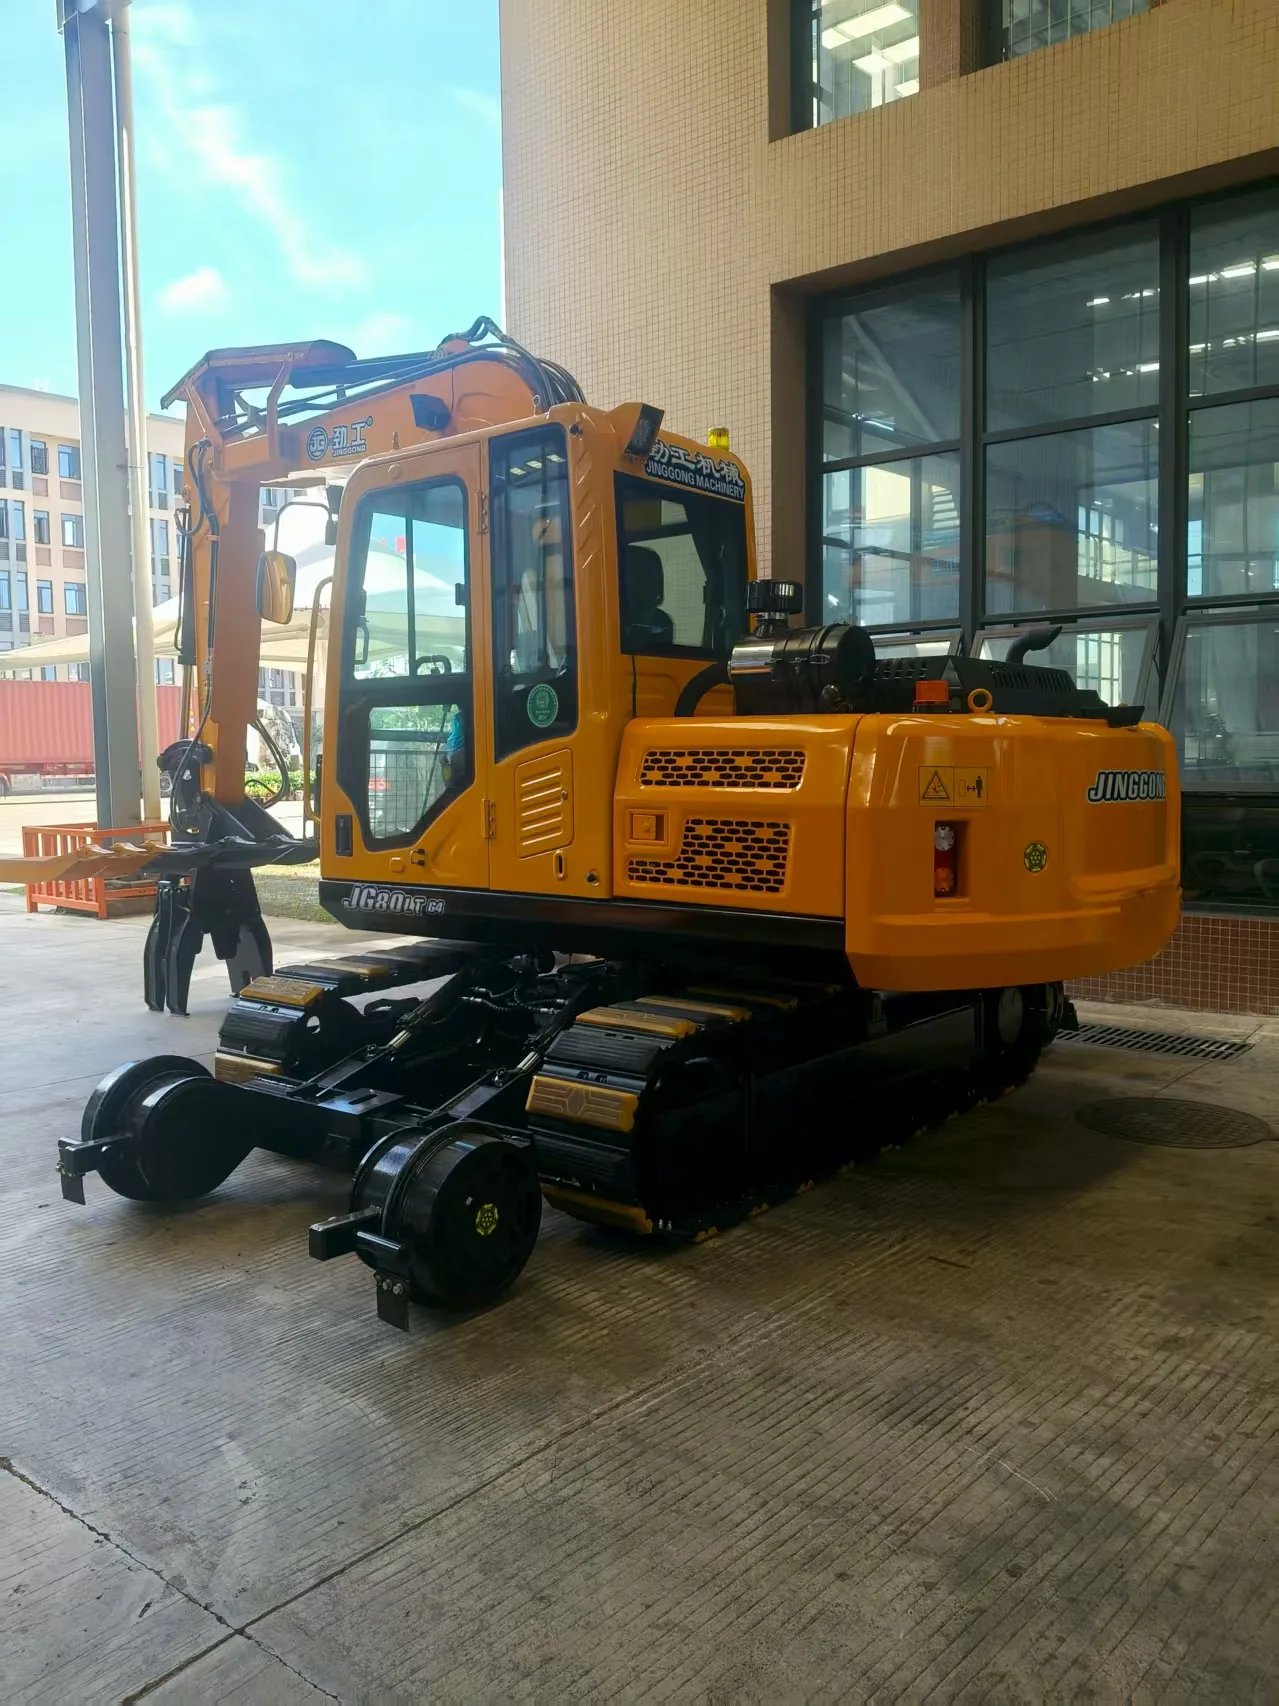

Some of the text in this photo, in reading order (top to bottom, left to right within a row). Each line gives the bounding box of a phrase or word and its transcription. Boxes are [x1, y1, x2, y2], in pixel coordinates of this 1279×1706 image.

[332, 425, 366, 448] 劲工
[646, 462, 744, 499] JINGGONG MACHINERY
